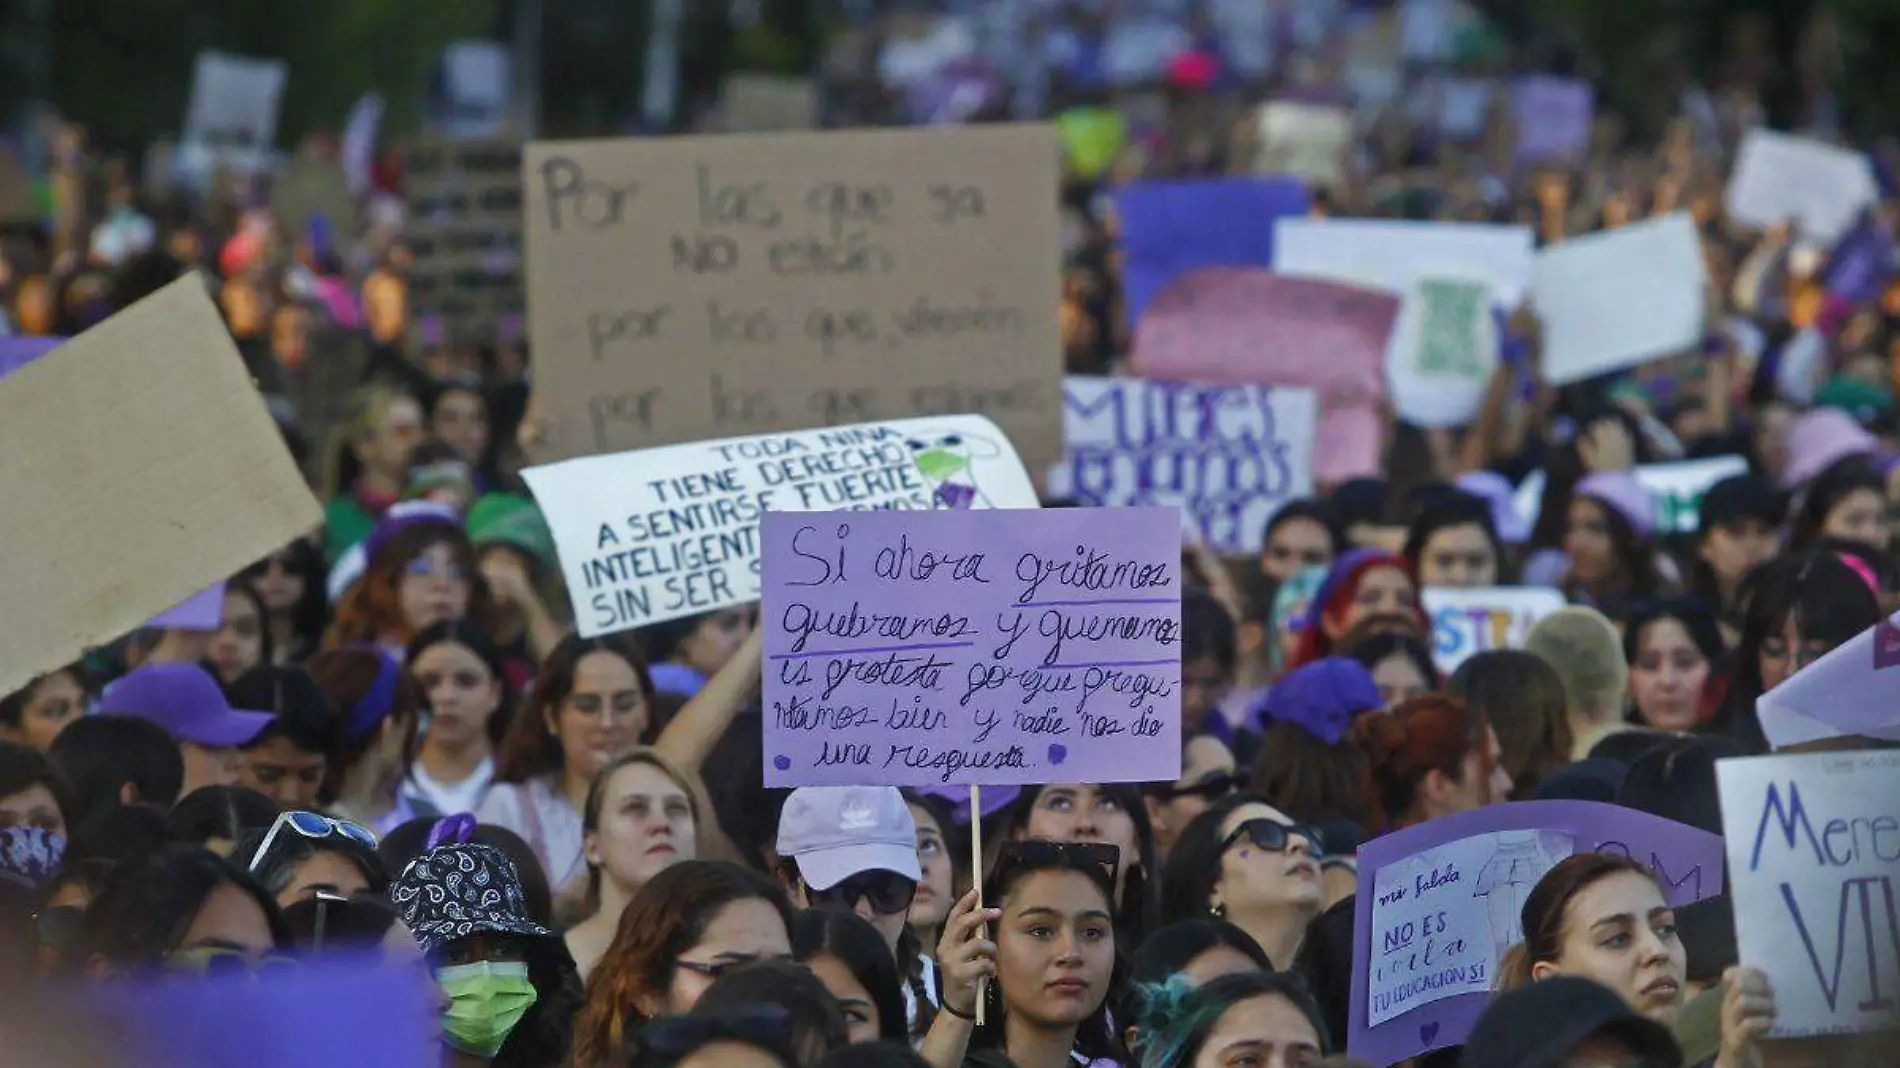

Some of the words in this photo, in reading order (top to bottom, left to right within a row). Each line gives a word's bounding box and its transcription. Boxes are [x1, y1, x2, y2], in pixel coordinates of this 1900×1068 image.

[537, 155, 641, 233] Por
[696, 162, 782, 229] las
[803, 180, 895, 241] que
[670, 231, 739, 276] NO
[586, 302, 671, 363] por
[647, 466, 745, 503] TIENE
[757, 441, 906, 485] DERECHO
[708, 435, 803, 462] TODA
[597, 521, 619, 549] A
[793, 463, 923, 508] FUERTE
[581, 525, 760, 589] INTELIGENT
[785, 524, 849, 586] Si
[875, 534, 990, 582] ahora
[1016, 545, 1171, 603] gritamos
[592, 585, 651, 628] SIN
[664, 567, 734, 611] SER
[783, 602, 979, 652] quebramos
[994, 613, 1030, 659] y
[821, 653, 953, 700] protesta
[884, 695, 947, 730] bien
[973, 708, 1001, 743] y
[1013, 706, 1070, 735] nadie
[1080, 711, 1125, 737] nos
[1131, 705, 1164, 736] dio
[814, 741, 871, 767] una
[1378, 887, 1406, 906] mi
[1384, 922, 1414, 953] NO
[1423, 912, 1448, 937] ES
